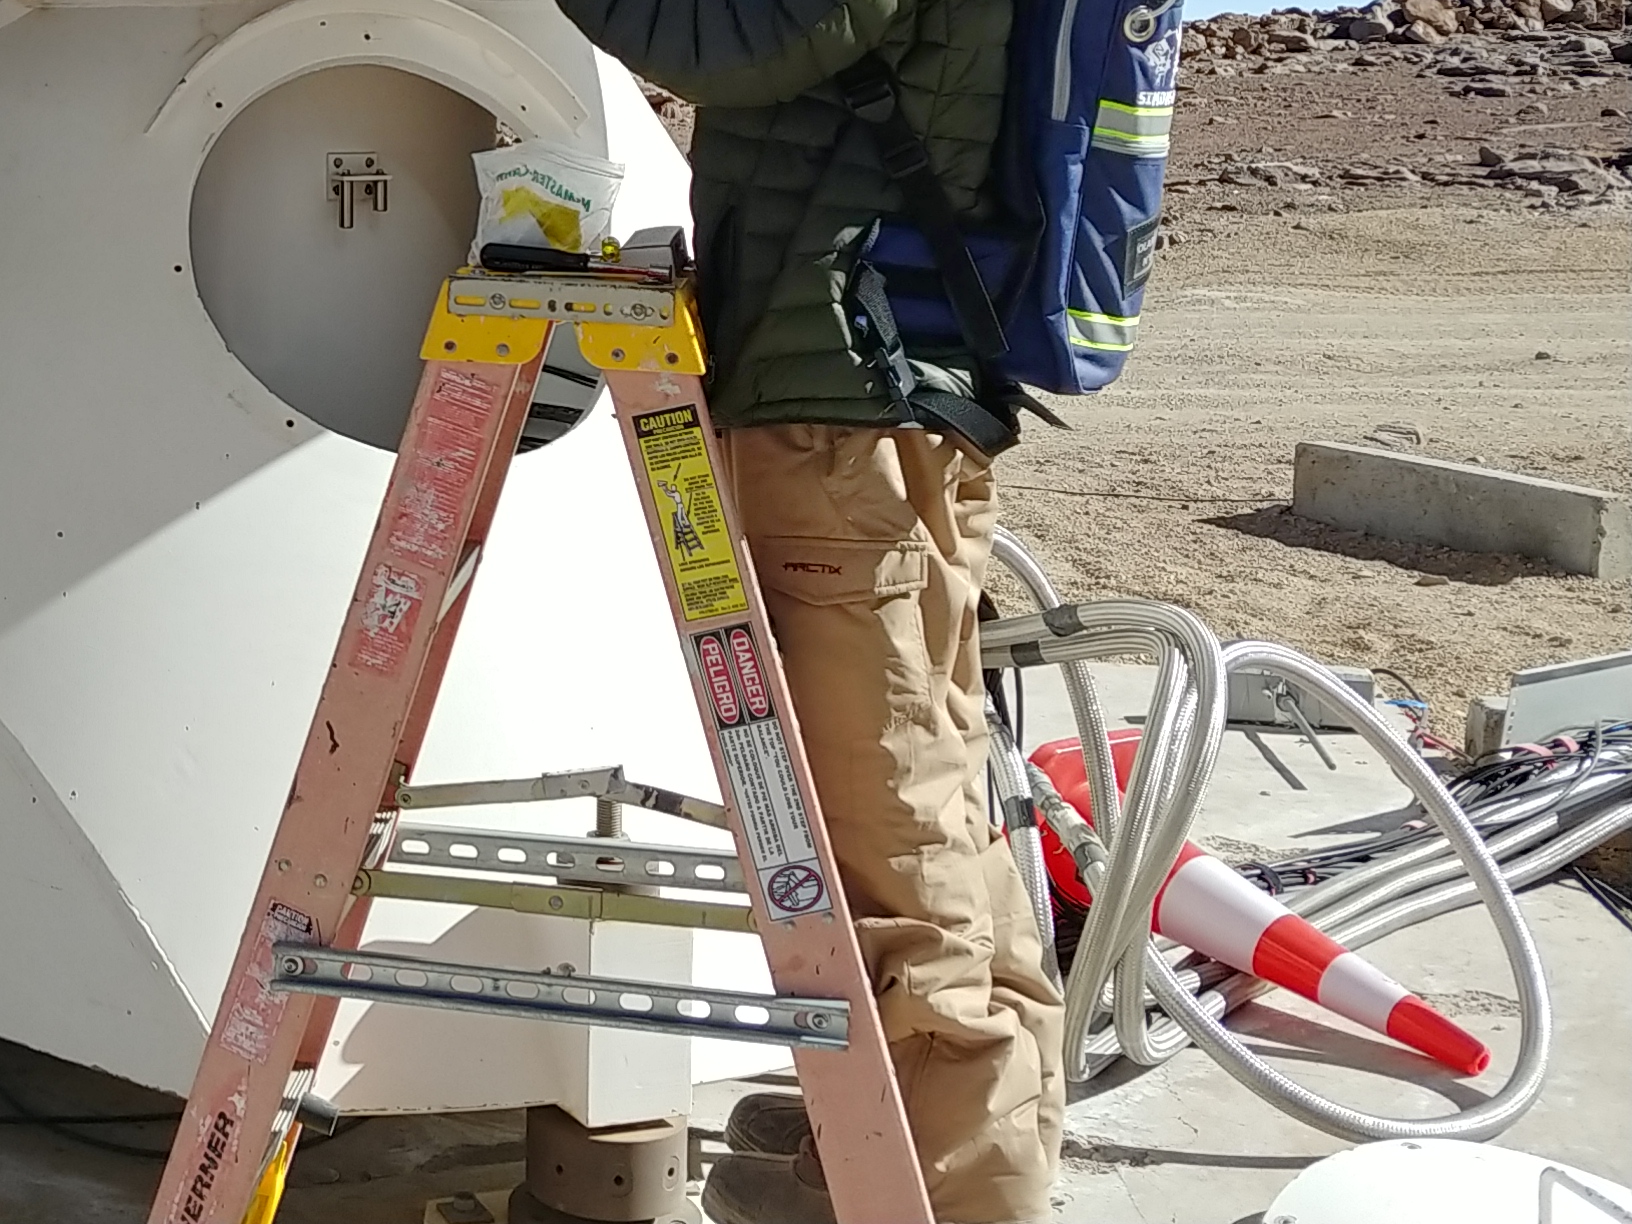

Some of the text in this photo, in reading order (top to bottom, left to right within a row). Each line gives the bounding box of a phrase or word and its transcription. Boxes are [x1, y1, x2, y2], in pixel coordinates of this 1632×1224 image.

[639, 407, 693, 433] CAUTION
[782, 562, 842, 576] ARCTIX
[701, 641, 737, 719] PELIGRO
[731, 635, 766, 711] DANGER
